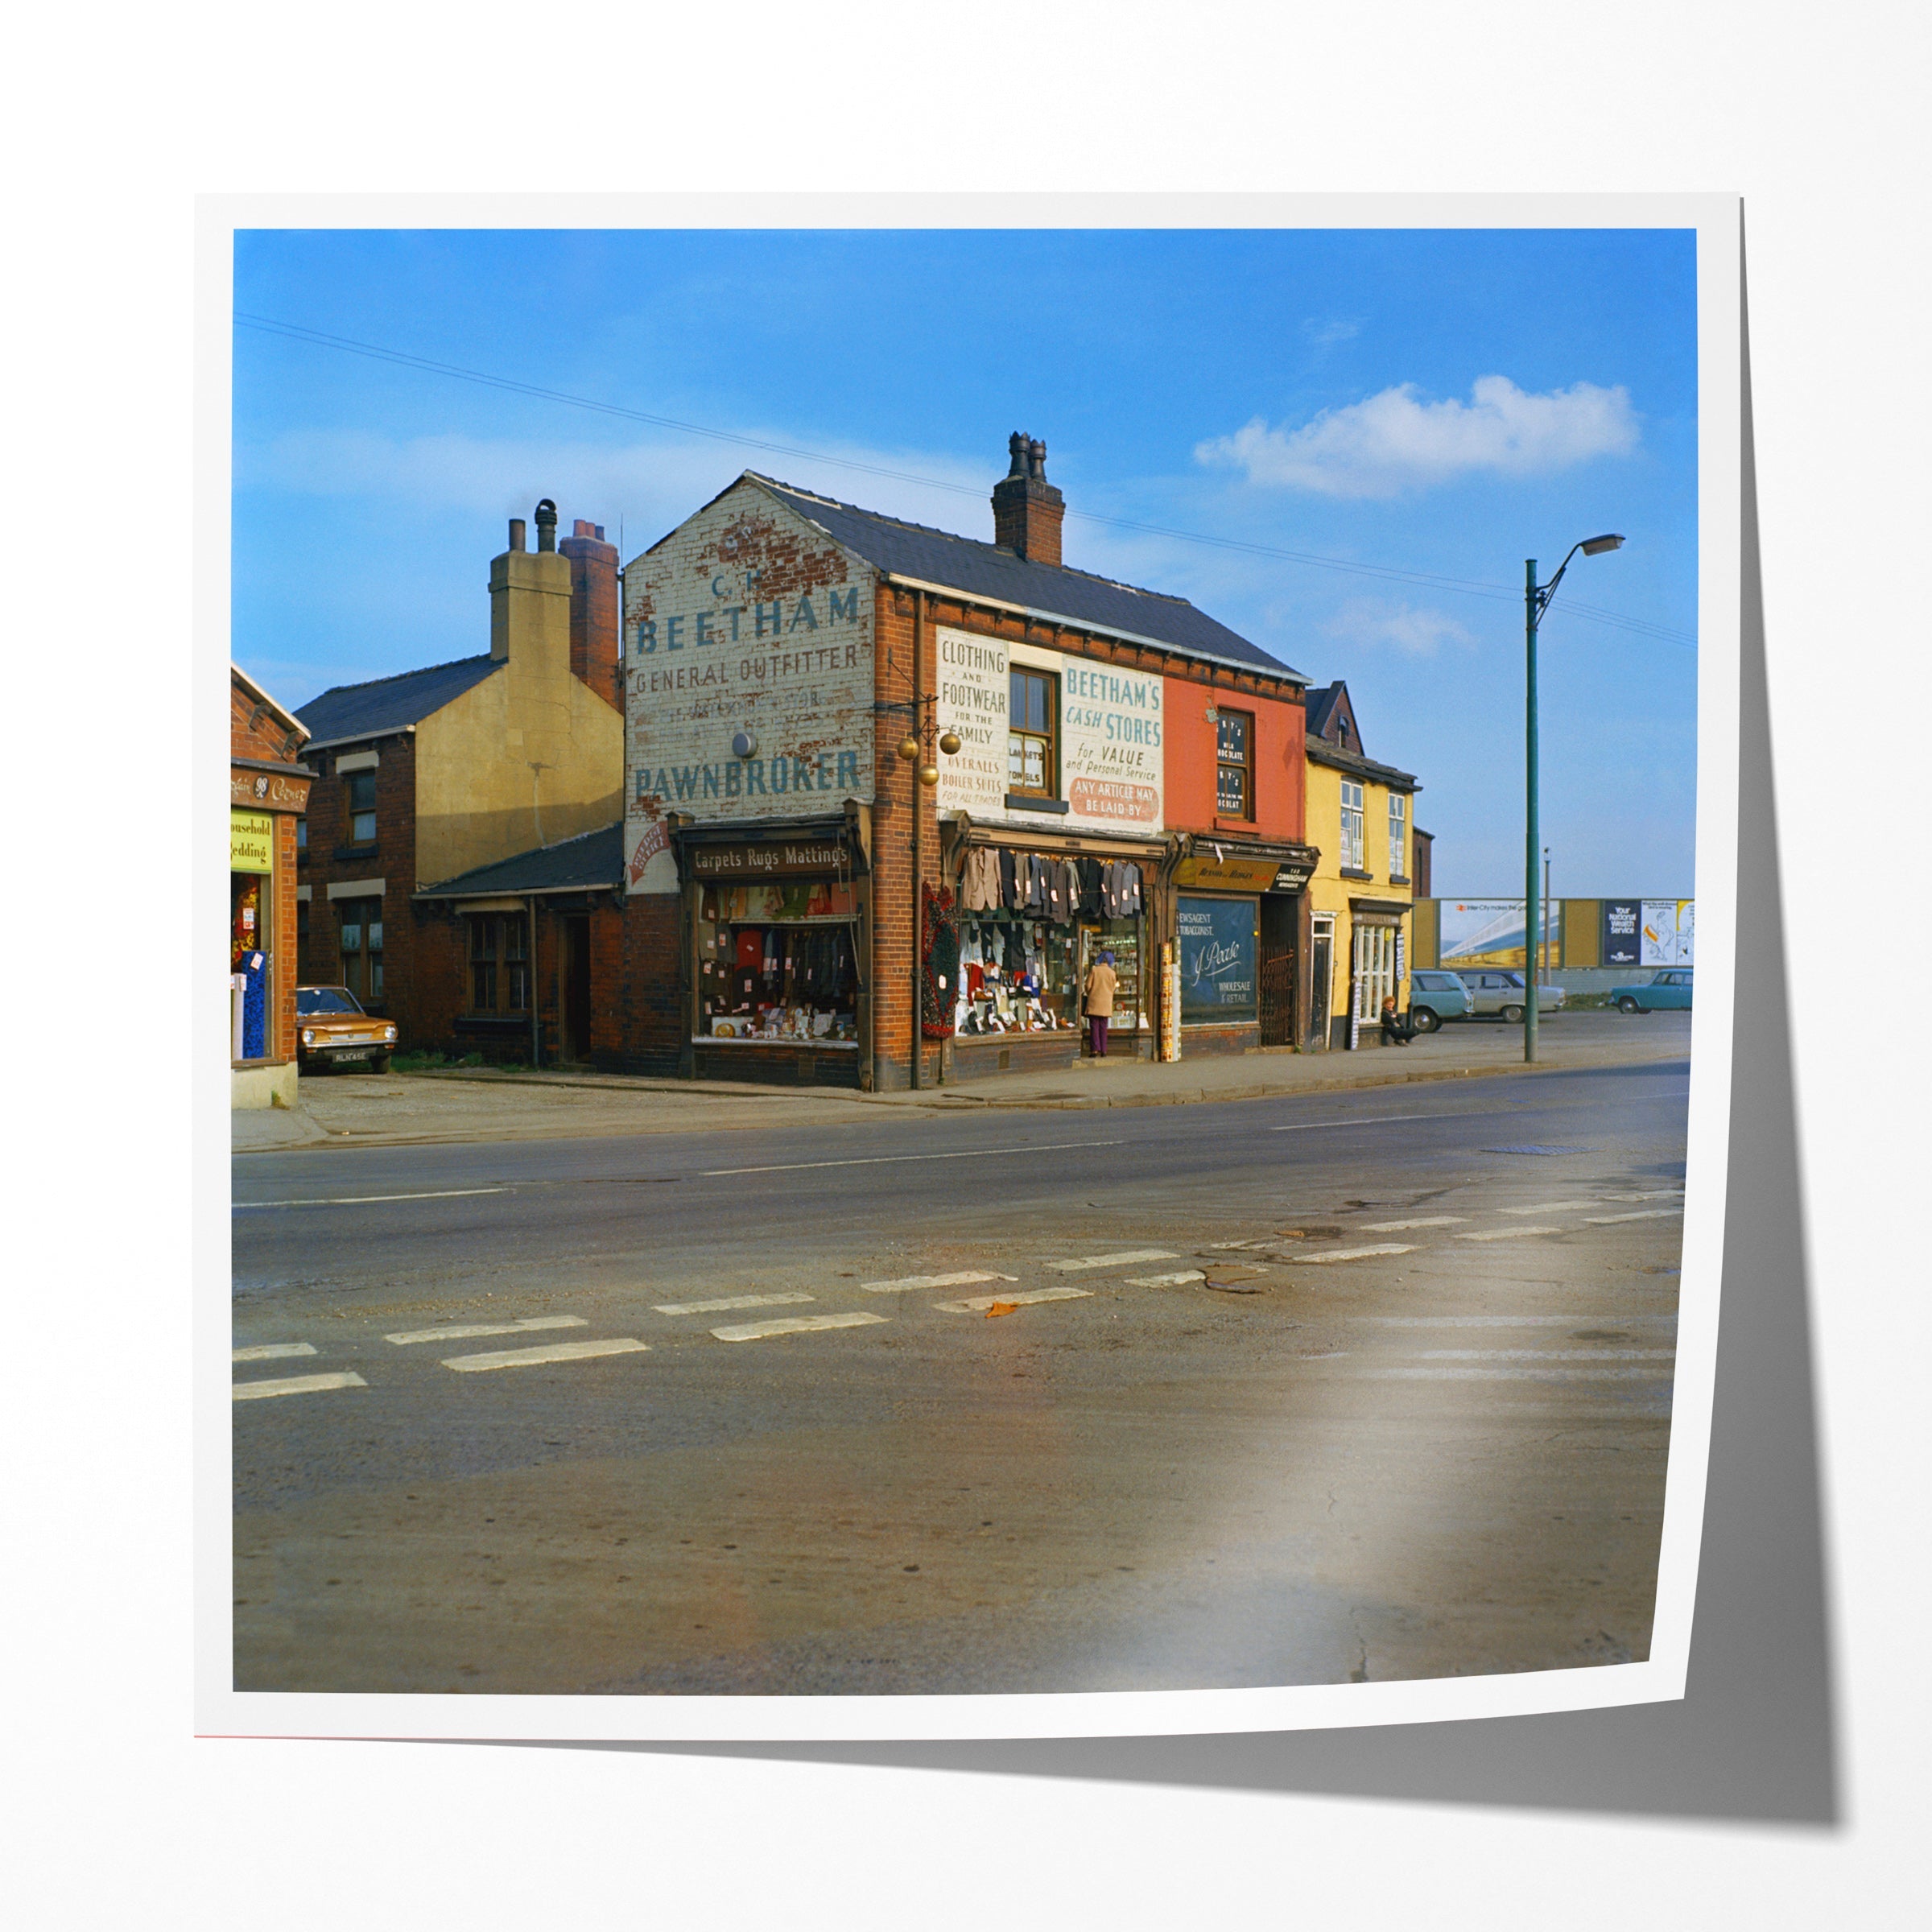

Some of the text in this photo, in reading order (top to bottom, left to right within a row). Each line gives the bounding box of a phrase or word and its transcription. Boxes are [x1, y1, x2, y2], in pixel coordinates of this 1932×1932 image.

[638, 587, 858, 655] BEETHAM
[943, 641, 1004, 673] CLOTHING
[637, 645, 857, 693] GENERAL OUTFITTER
[962, 672, 981, 683] AND
[943, 683, 1005, 714] FOOTWEAR
[1067, 667, 1159, 710] BEETHAM'S
[956, 712, 992, 724] FOR THE
[1066, 706, 1160, 747] CASH STORES
[951, 724, 993, 744] FAMILY
[1077, 742, 1144, 766] for VALUE
[635, 750, 861, 803] PAWNBROKER
[948, 757, 999, 774] OVERALLS
[1066, 759, 1083, 770] and
[1126, 766, 1156, 781] Service
[256, 778, 267, 792] 98
[272, 778, 306, 802] Corner
[943, 774, 1001, 793] BOILER SUITS
[1075, 781, 1154, 801] ANY ARTICLE MAY
[1086, 799, 1141, 816] BE LAID BY
[231, 819, 270, 836] ousehold
[231, 842, 266, 865] edding
[696, 845, 848, 872] Carpets Rugs Mattings
[1608, 913, 1637, 921] National
[1615, 906, 1631, 914] Your
[1219, 981, 1251, 992] WHOLESALE
